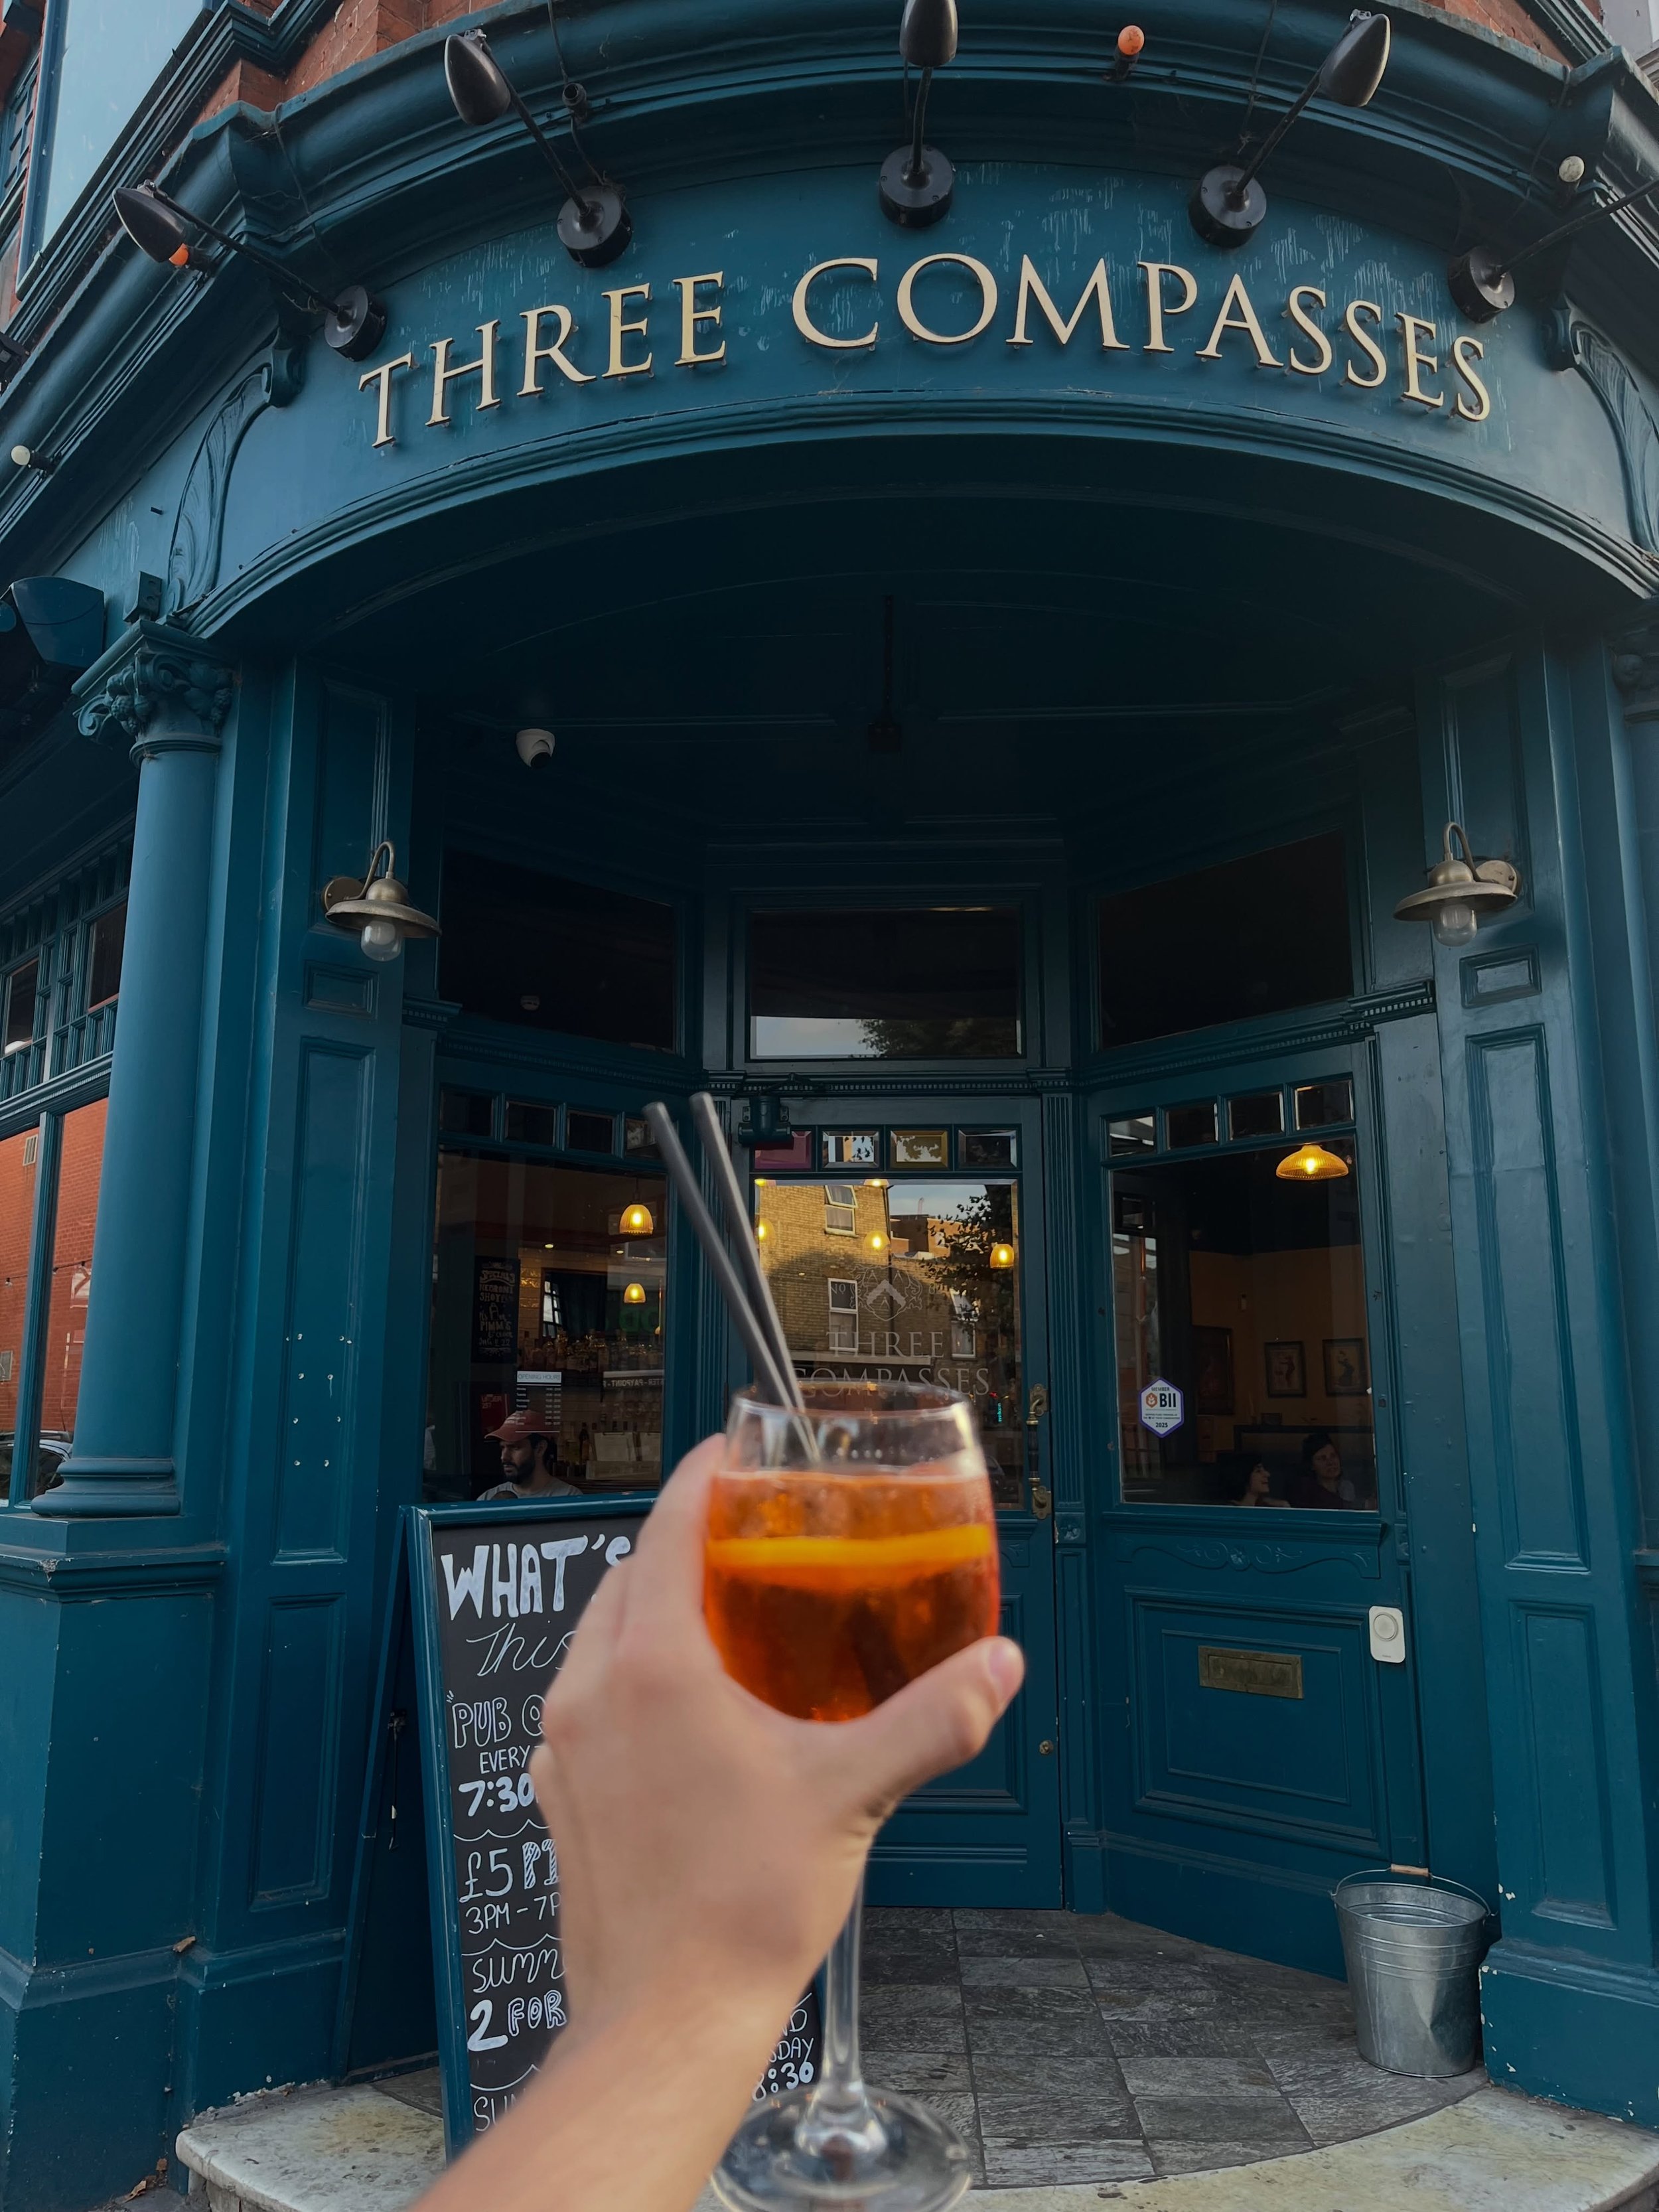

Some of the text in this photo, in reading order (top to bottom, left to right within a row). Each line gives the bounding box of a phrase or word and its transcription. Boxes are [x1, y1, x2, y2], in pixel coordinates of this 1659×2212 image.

[358, 253, 1491, 449] THREE COMPASSES
[826, 1331, 945, 1358] THREE
[794, 1368, 989, 1396] COMPASSES
[452, 1697, 512, 1749] PUB
[480, 1745, 530, 1774] EVERY
[459, 1773, 535, 1817] 7:30
[459, 1848, 514, 1903] £5
[466, 1902, 510, 1934] 3PM
[534, 1892, 561, 1920] 7P
[472, 1949, 567, 1993] SUMM
[467, 1990, 567, 2051] 2 FOR
